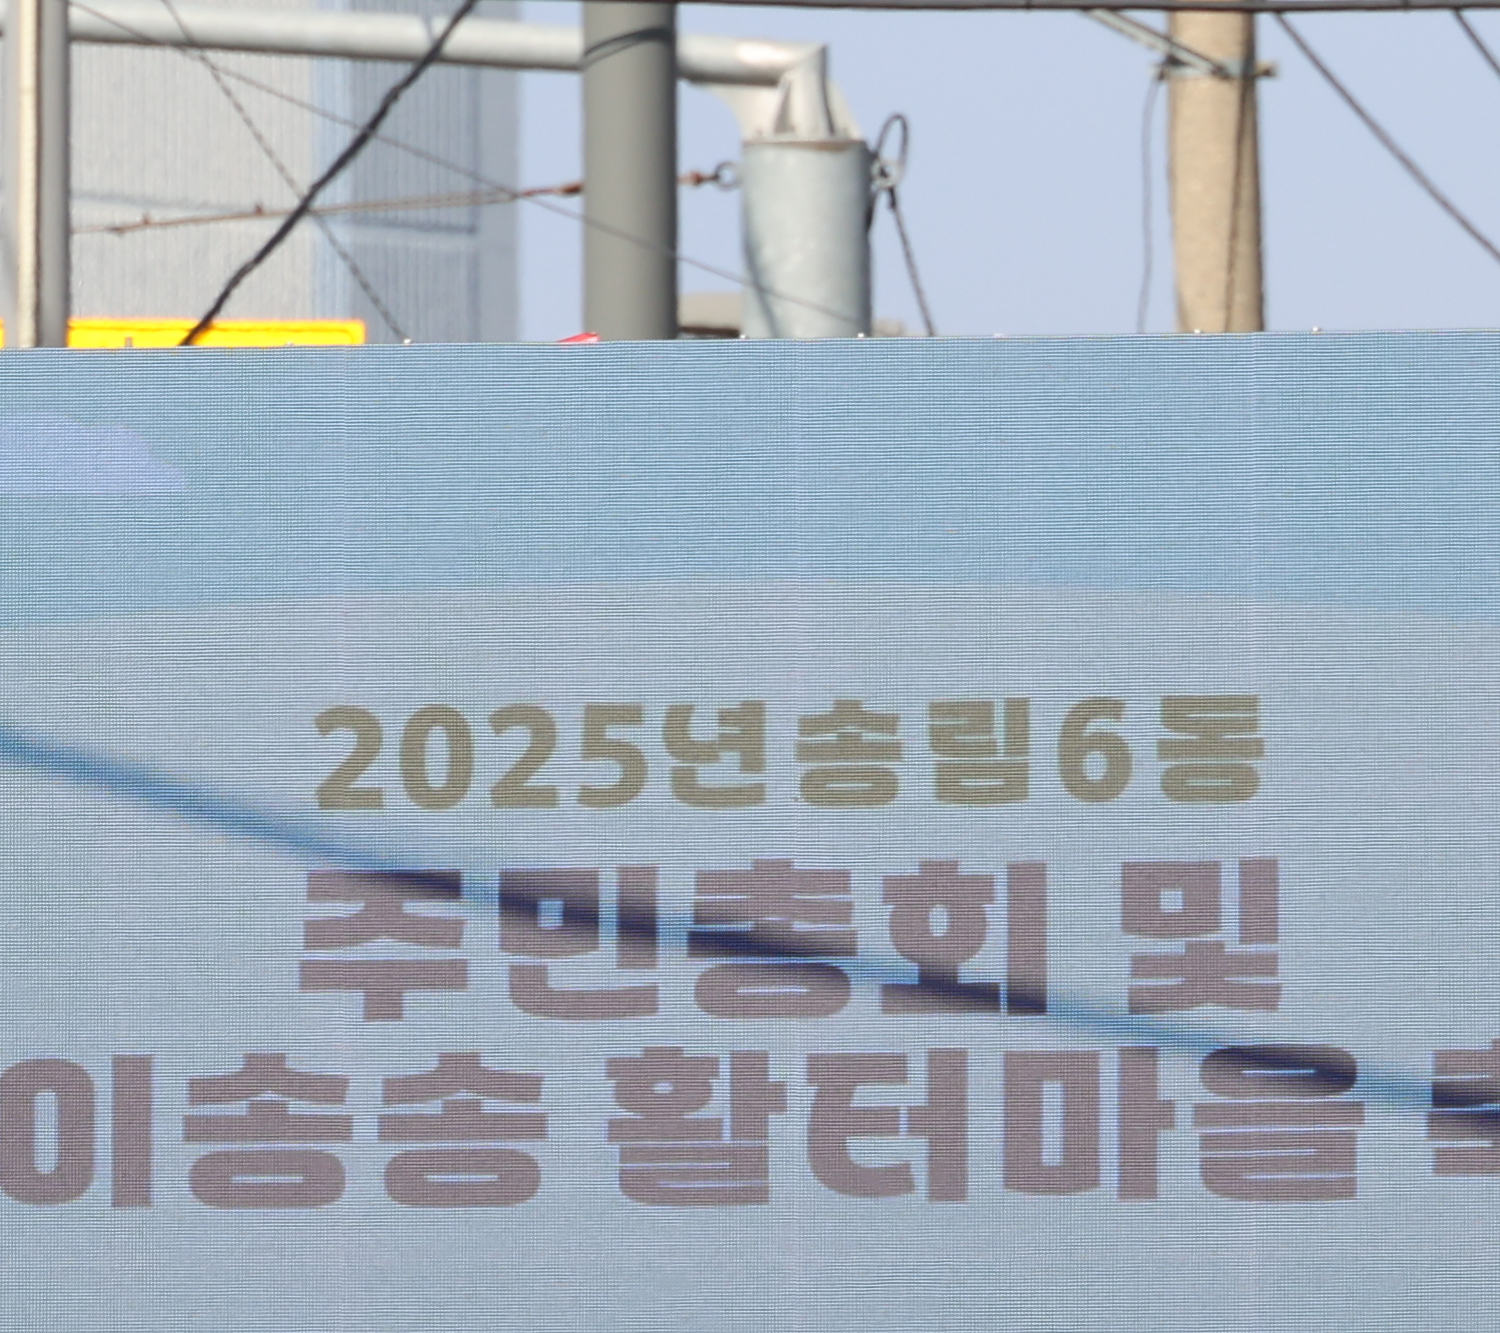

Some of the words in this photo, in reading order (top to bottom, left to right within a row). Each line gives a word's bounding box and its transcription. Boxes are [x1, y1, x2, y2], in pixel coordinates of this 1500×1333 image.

[299, 857, 1048, 1022] 주민총회
[1121, 856, 1282, 1015] 및
[604, 1043, 1365, 1207] 활터마을
